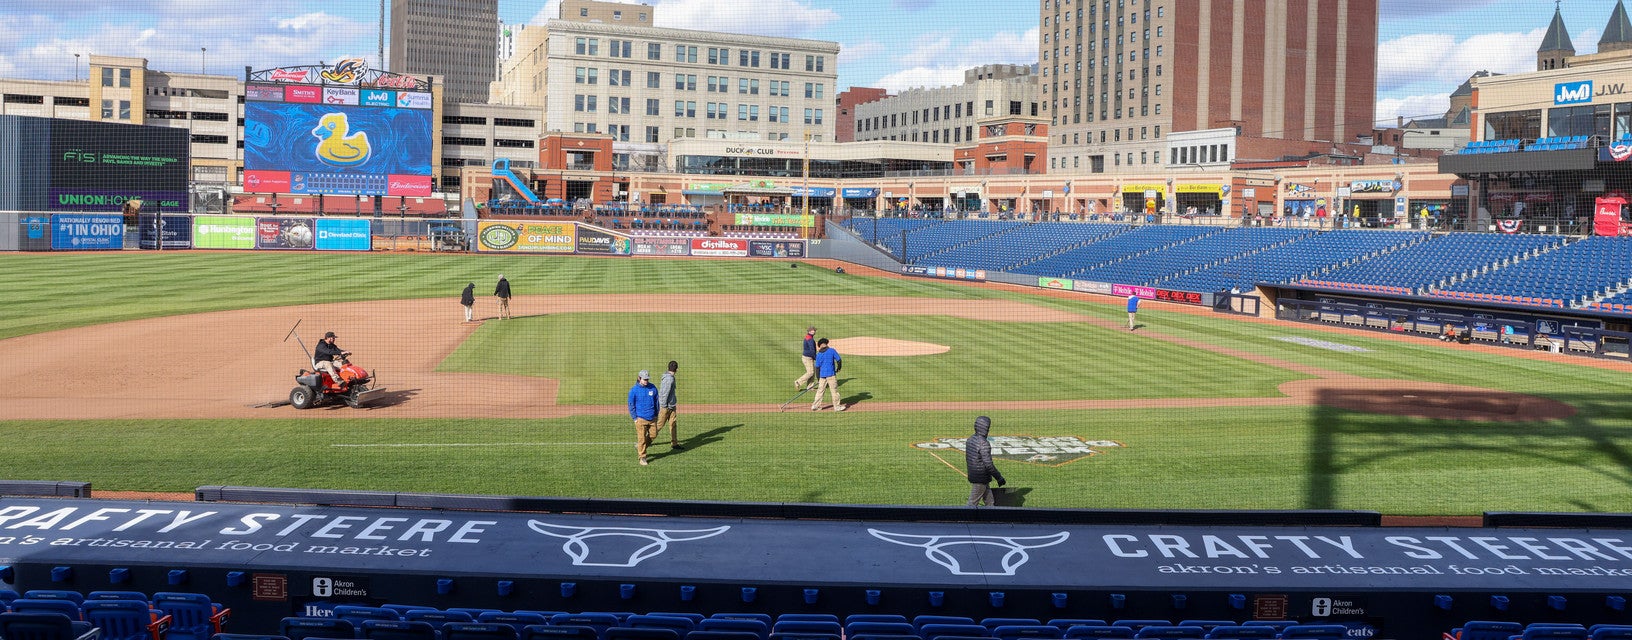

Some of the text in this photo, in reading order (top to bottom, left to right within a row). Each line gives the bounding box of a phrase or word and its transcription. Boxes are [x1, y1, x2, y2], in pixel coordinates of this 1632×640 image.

[326, 88, 356, 96] KeyBank
[1595, 83, 1626, 96] J.W.
[60, 224, 120, 236] #1 IN OHIO
[210, 224, 253, 236] Huntington
[528, 226, 563, 235] PEACE
[528, 235, 572, 244] OF MIND
[219, 512, 498, 544] STEERE
[50, 537, 209, 550] artisanal
[214, 540, 300, 552] food
[303, 544, 432, 557] market
[1102, 534, 1364, 559] CRAFTY
[1157, 563, 1282, 574] akron's
[1290, 564, 1444, 575] artisanal
[1448, 565, 1530, 575] food
[333, 588, 367, 596] Children's
[1346, 626, 1374, 637] eats
